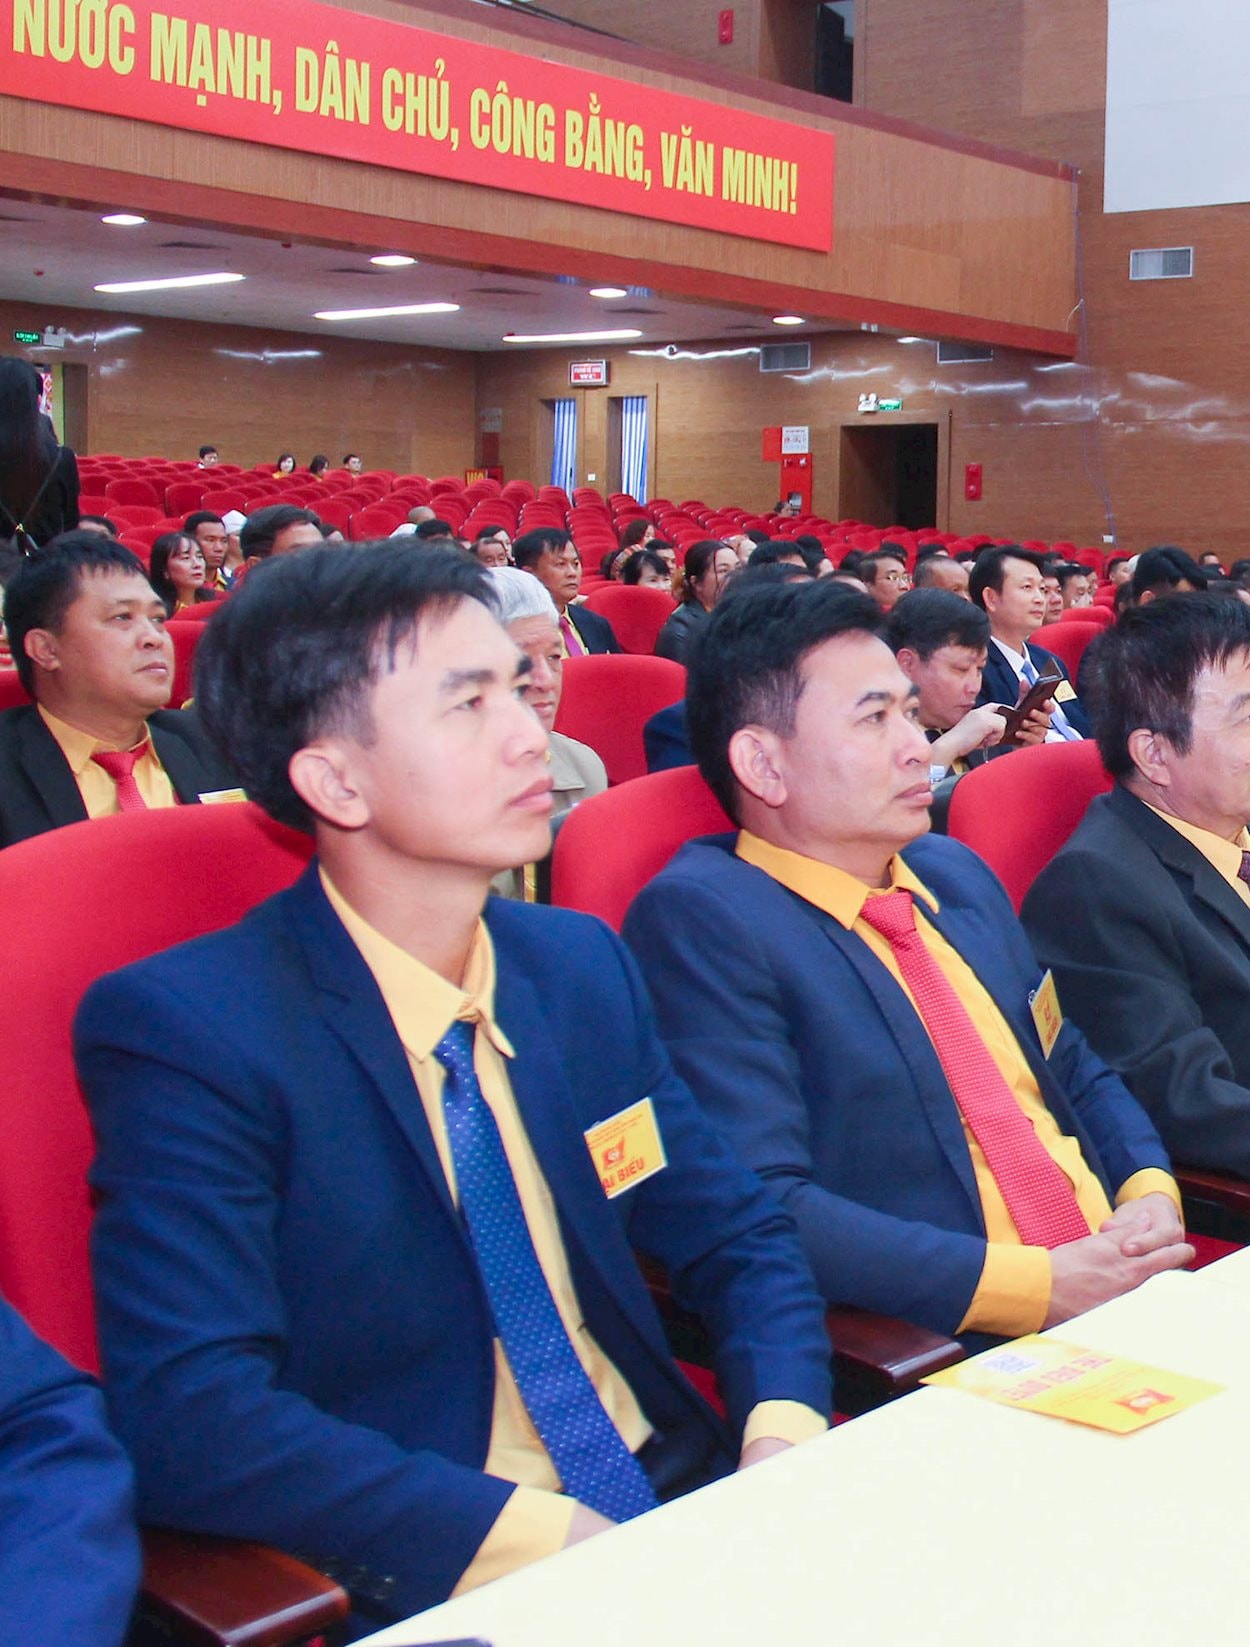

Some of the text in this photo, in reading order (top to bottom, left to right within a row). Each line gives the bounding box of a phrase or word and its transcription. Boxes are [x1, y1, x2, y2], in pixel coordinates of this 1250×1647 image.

[13, 0, 798, 215] NƯỚC MẠNH, DÂN CHỦ, CÔNG BẰNG, VĂN MINH!
